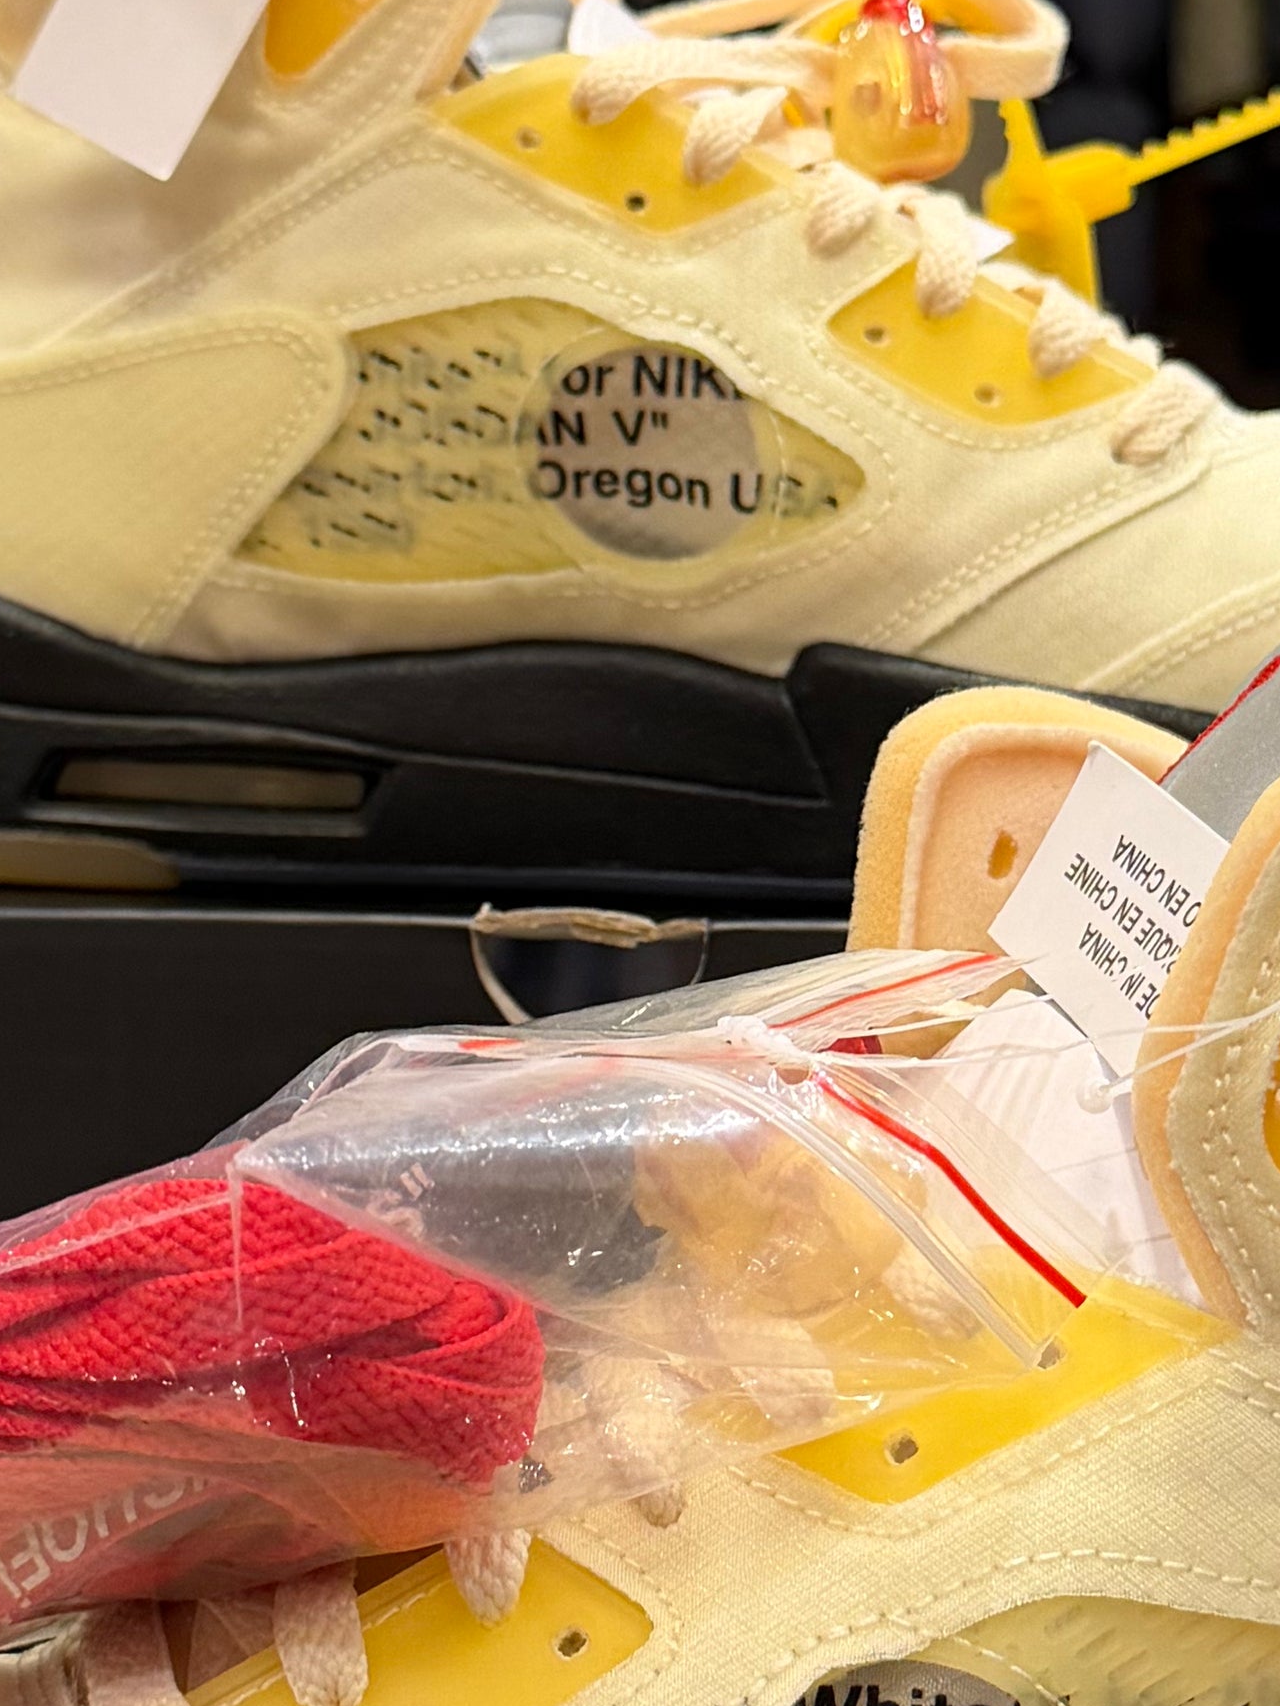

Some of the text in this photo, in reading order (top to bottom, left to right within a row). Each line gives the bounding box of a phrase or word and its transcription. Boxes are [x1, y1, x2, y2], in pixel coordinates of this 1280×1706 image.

[633, 355, 744, 400] NIK
[612, 410, 669, 445] V"
[528, 460, 710, 509] Oregon
[1064, 853, 1118, 911] CHINE
[1112, 834, 1166, 893] CHINA
[1112, 897, 1144, 934] EN
[1158, 879, 1190, 916] EN
[1079, 922, 1128, 977] CHINA
[1120, 972, 1145, 1000] IN
